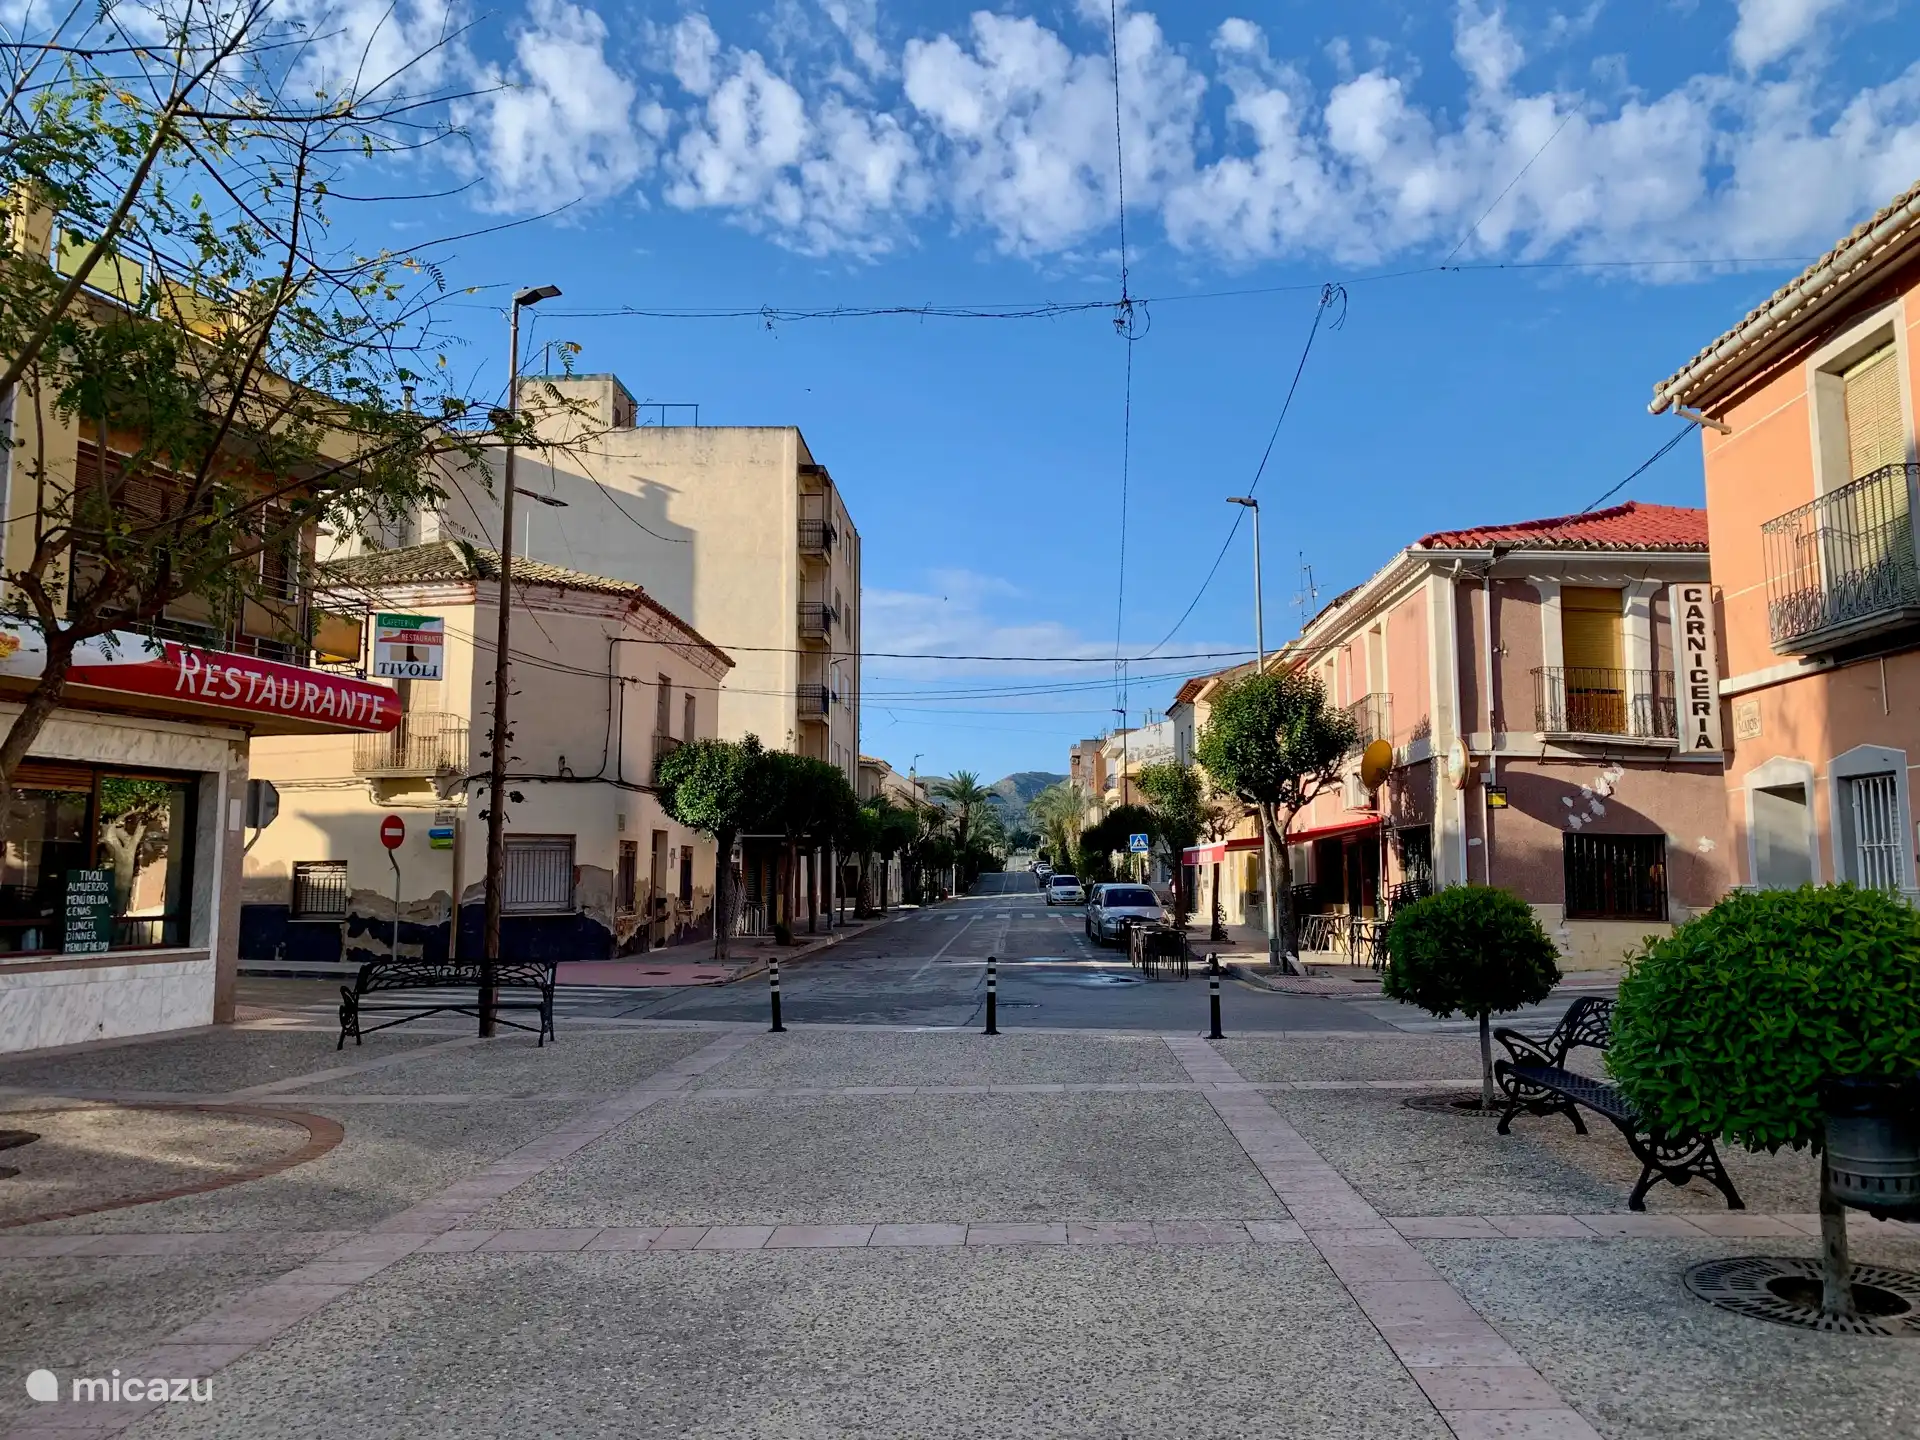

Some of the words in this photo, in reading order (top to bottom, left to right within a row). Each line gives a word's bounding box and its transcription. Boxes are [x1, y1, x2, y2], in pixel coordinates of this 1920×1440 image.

[379, 662, 438, 677] TIVOLI
[1684, 588, 1713, 749] CARNICERIA
[175, 649, 385, 725] RESTAURANTE
[80, 870, 103, 881] TIVOLI
[67, 882, 109, 892] ALMUERZOS
[66, 906, 92, 916] CENAS
[67, 921, 94, 931] LUNCH
